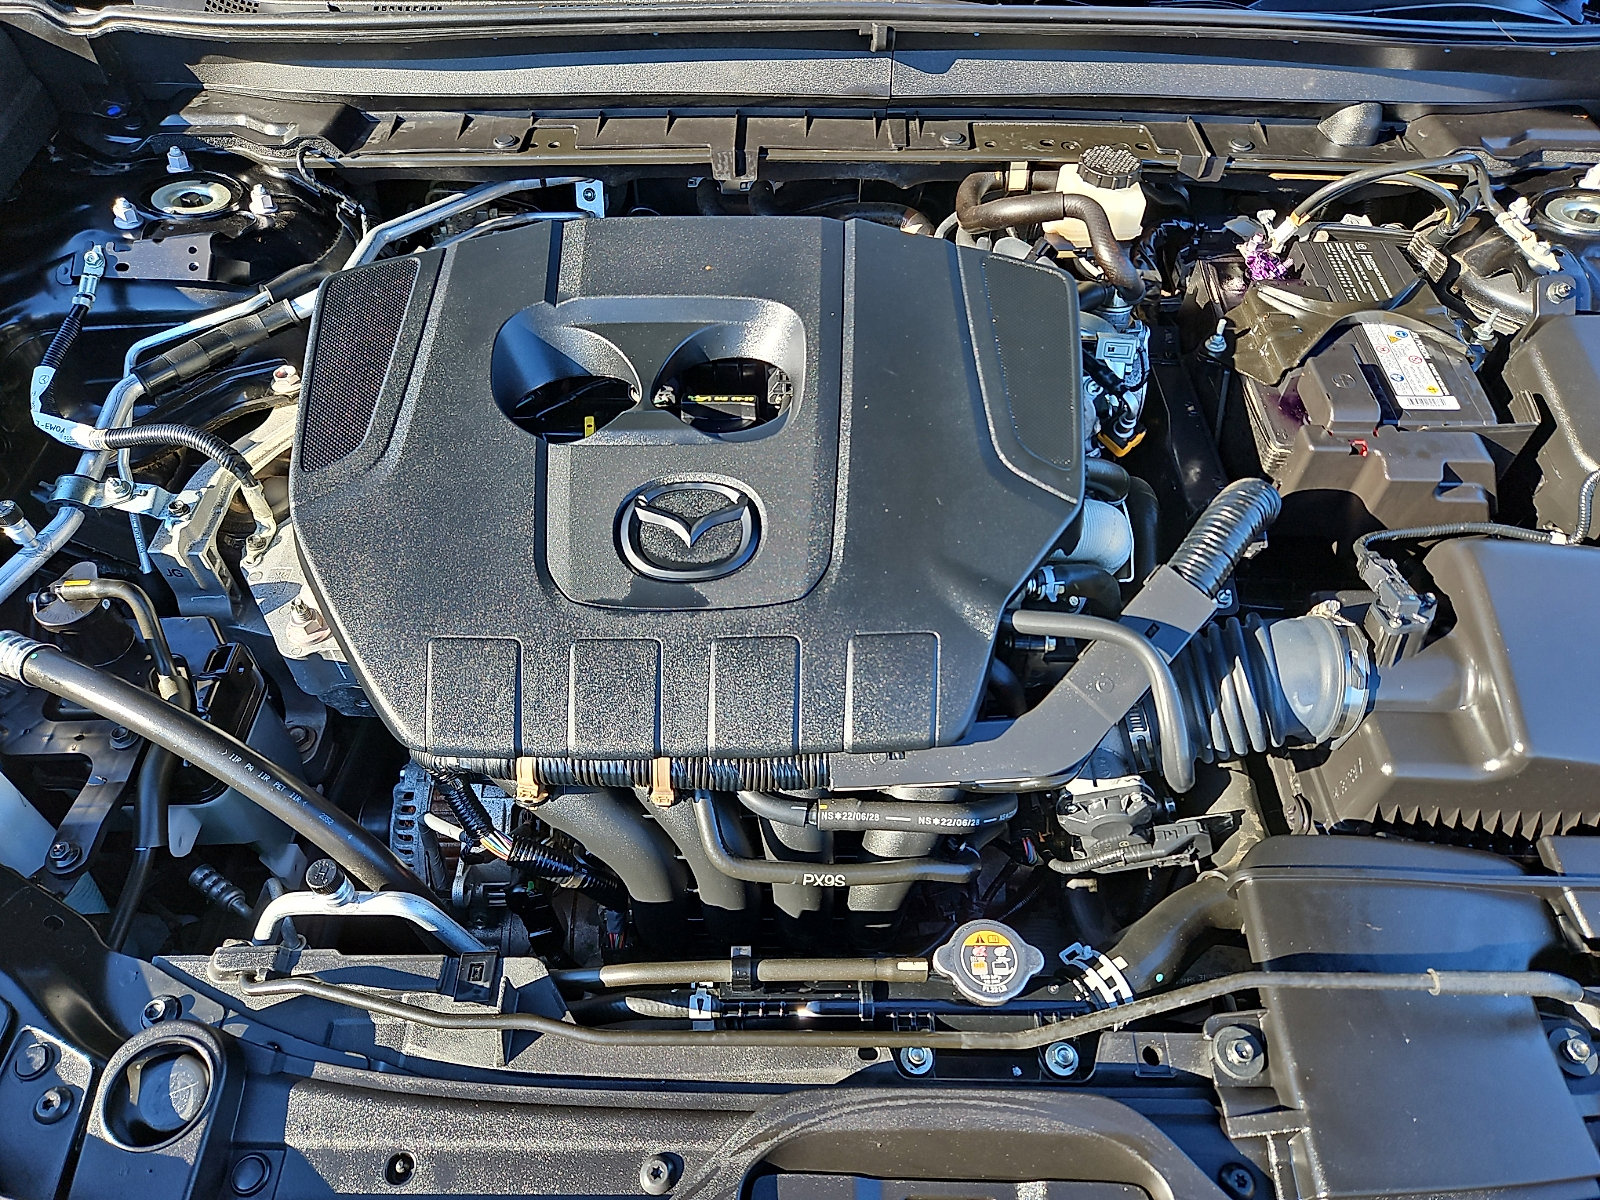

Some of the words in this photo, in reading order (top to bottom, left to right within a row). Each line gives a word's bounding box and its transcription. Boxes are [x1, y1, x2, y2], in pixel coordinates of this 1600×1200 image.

[167, 568, 184, 578] JG
[272, 781, 287, 792] PET
[802, 873, 846, 887] PX9S
